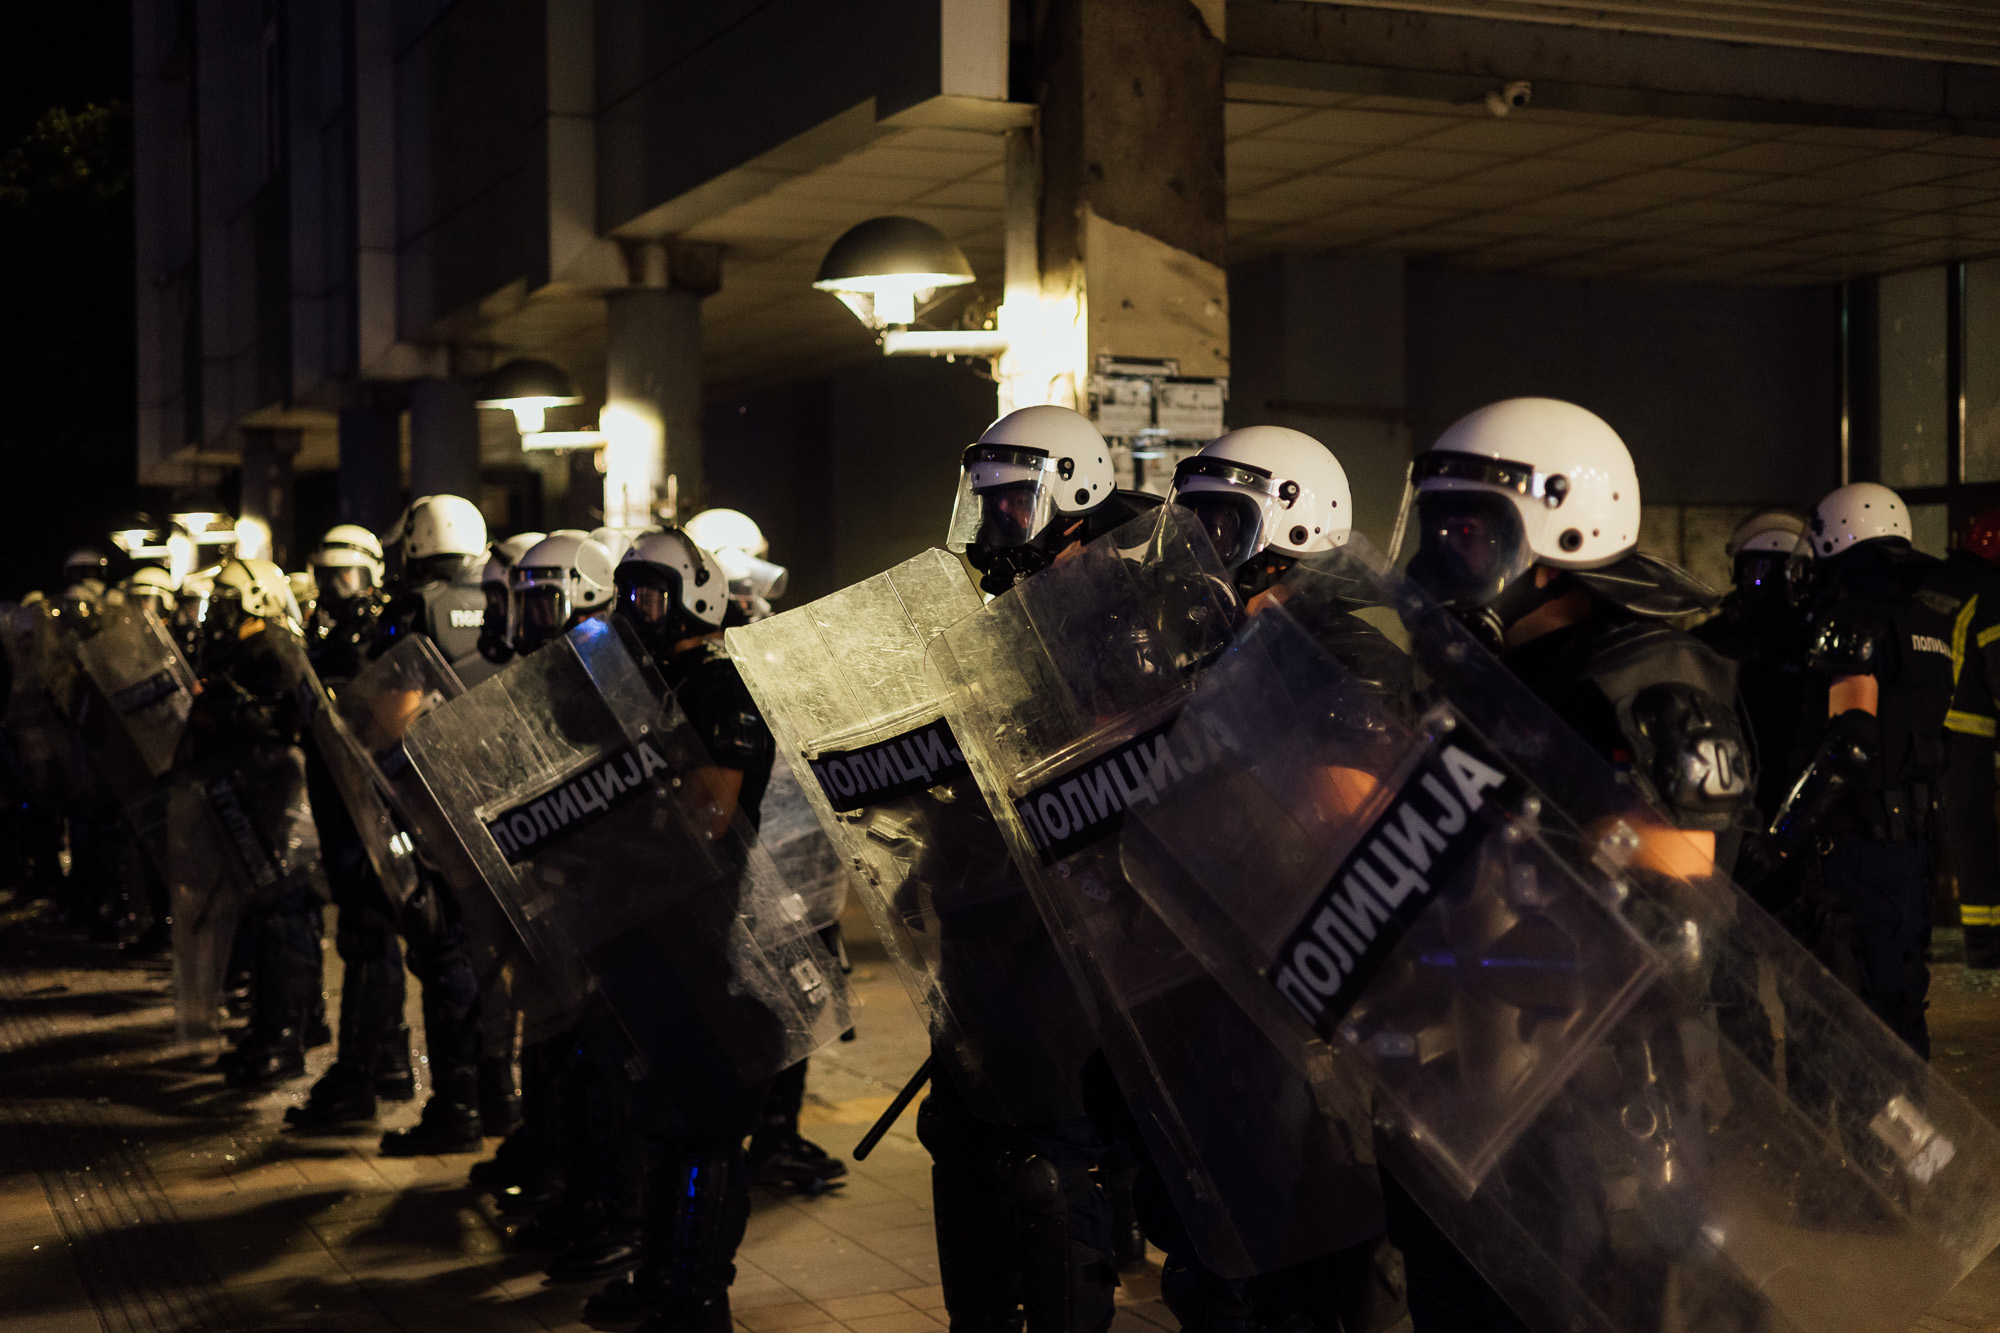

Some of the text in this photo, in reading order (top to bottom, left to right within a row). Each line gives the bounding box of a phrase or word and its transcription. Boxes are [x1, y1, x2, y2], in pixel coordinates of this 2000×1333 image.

[490, 741, 668, 857] ПОЛИЦИЈА
[1018, 711, 1243, 851] ПОЛИЦИЈА
[1276, 744, 1508, 1026] ПОЛИЦИЈА
